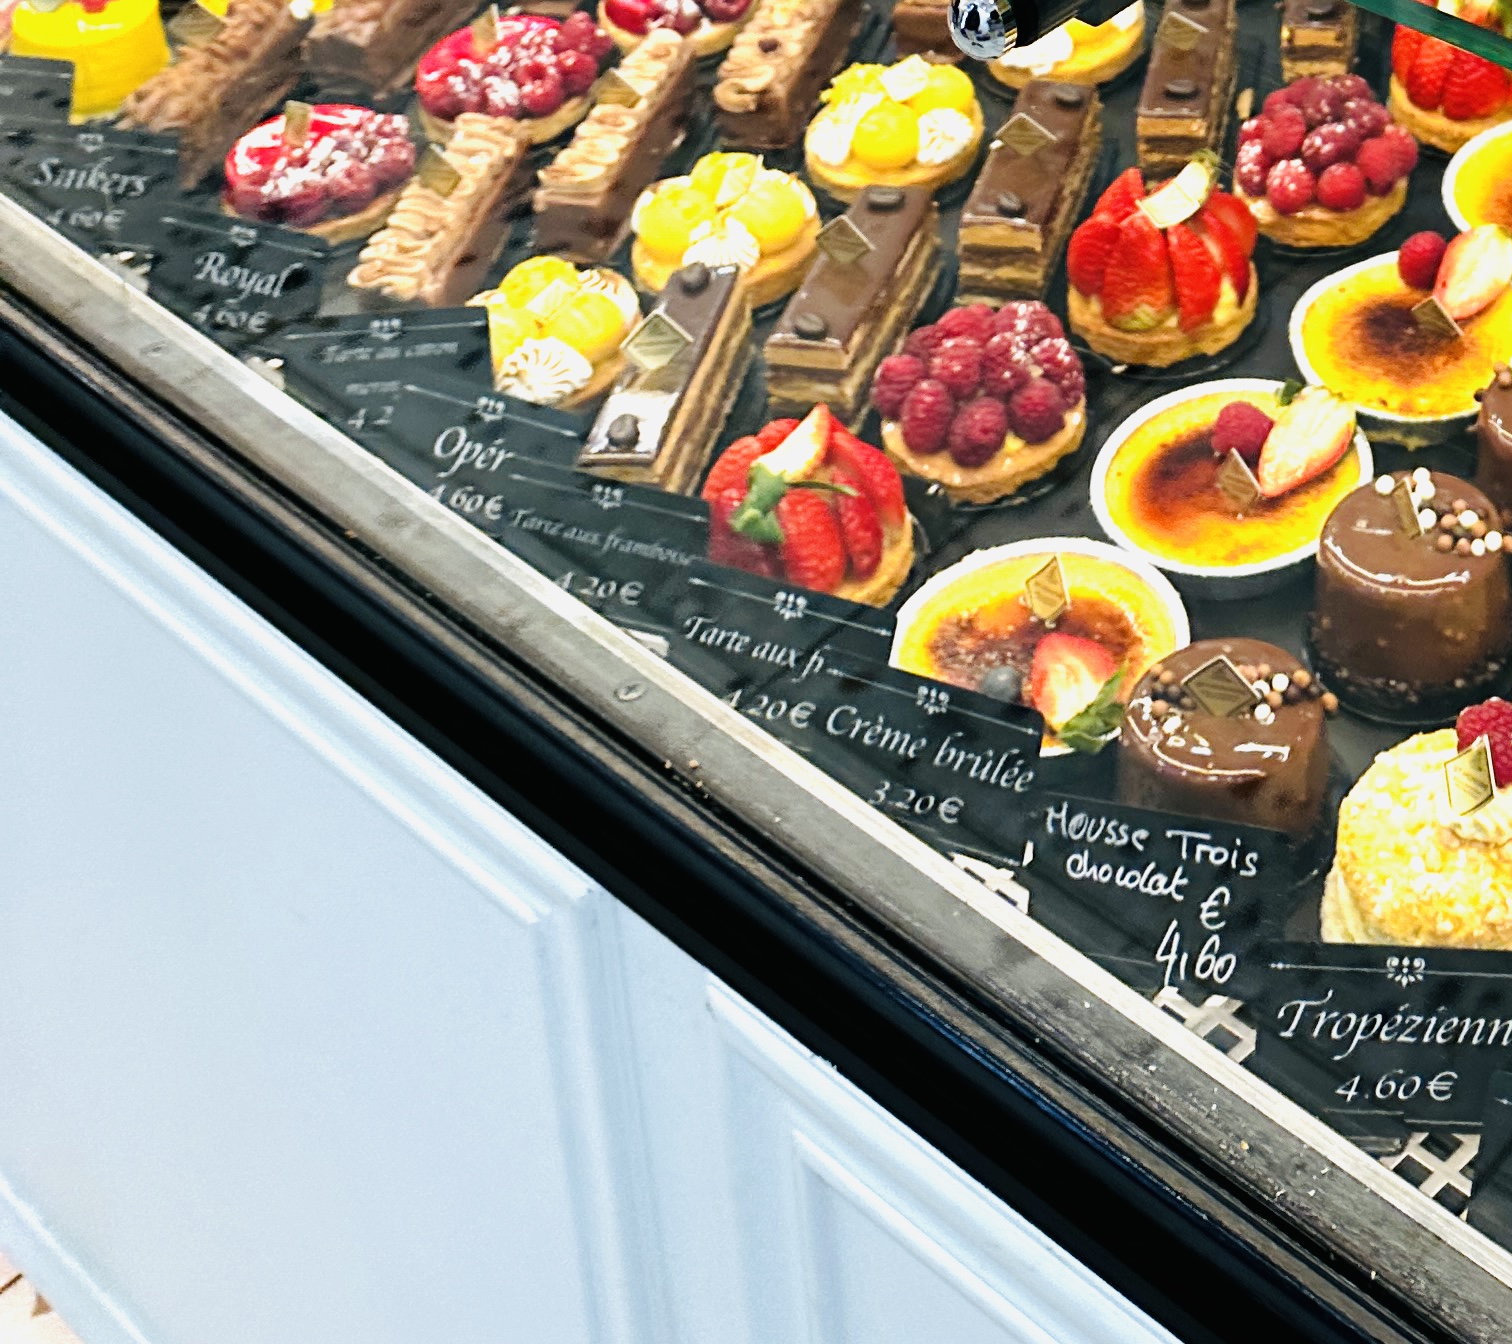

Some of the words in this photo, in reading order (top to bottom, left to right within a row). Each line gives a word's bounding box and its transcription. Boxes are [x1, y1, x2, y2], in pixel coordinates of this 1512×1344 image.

[194, 251, 304, 304] Royal
[433, 426, 515, 478] Opér
[684, 615, 751, 654] Tarte
[752, 641, 799, 669] aux
[825, 705, 928, 758] Crème
[933, 733, 1036, 794] brûlée
[1165, 829, 1259, 877] Trois
[1335, 1068, 1458, 1103] 4.60€
